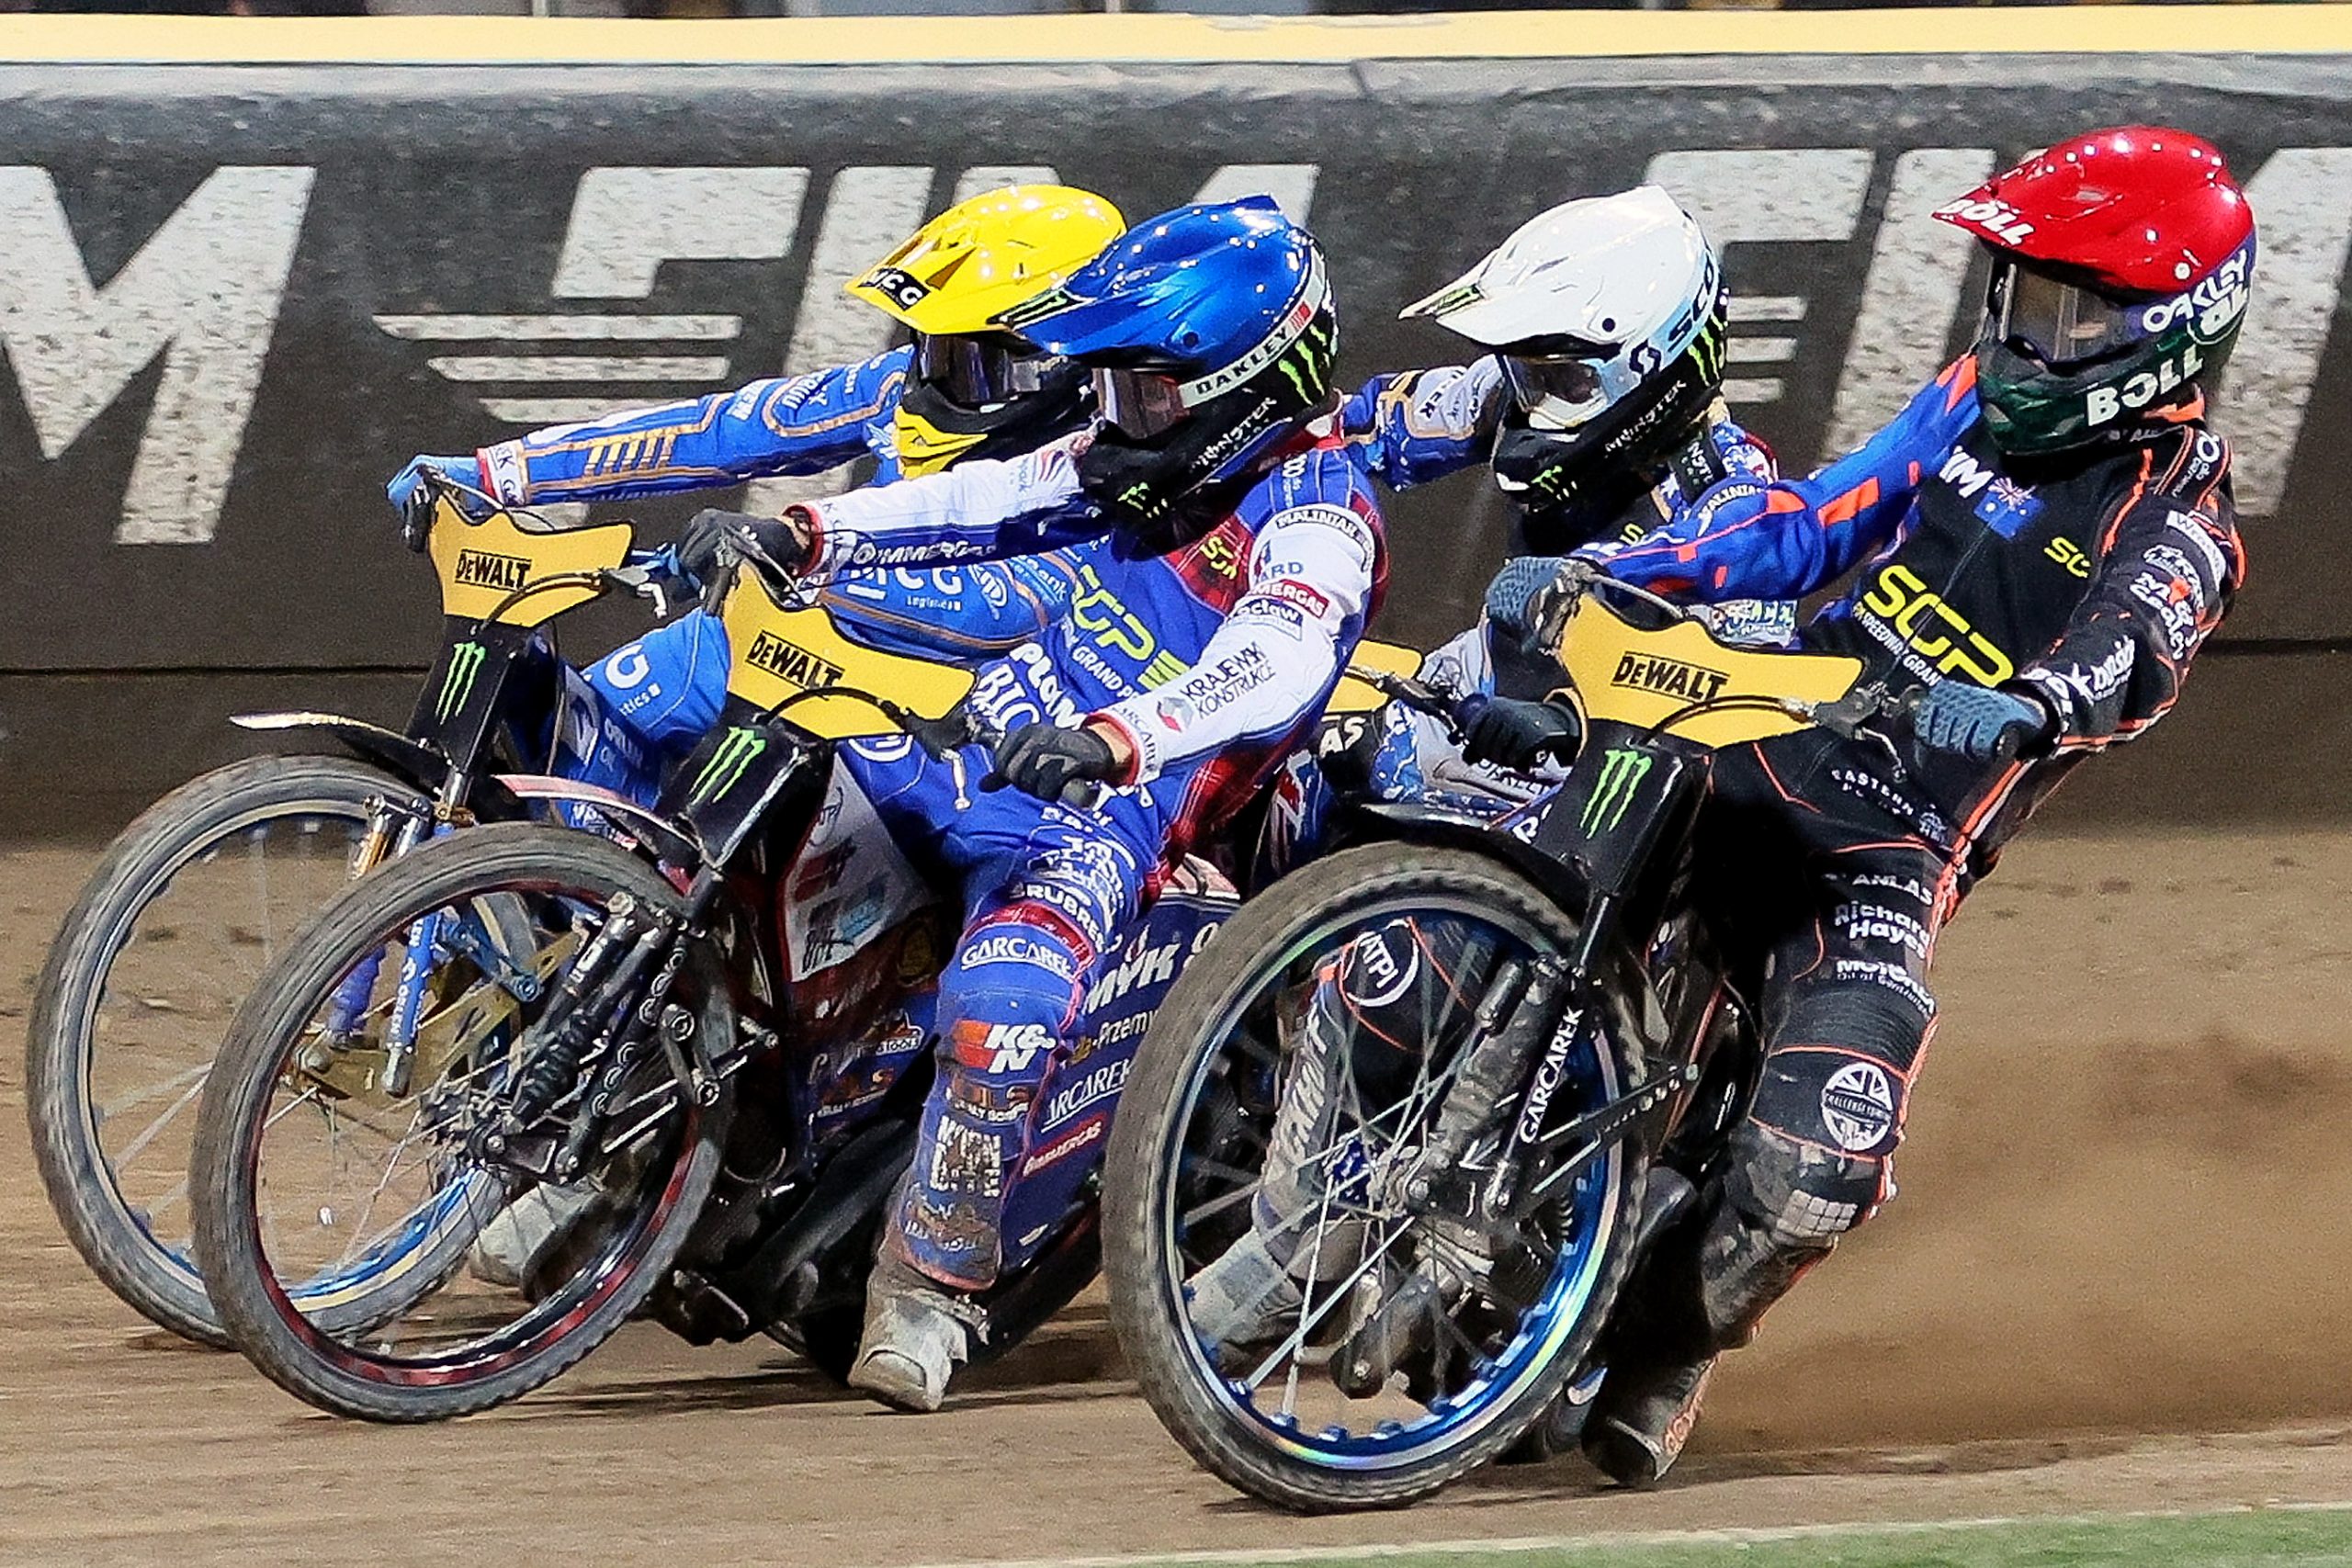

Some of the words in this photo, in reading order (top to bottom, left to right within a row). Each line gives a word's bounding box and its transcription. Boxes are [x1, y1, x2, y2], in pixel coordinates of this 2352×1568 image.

[2142, 249, 2248, 333] OAKLEY
[1194, 326, 1288, 396] OAKLEY
[1071, 646, 1124, 691] GRAND
[1902, 652, 1943, 688] GRAN
[1517, 1007, 1584, 1145] GARCAREK
